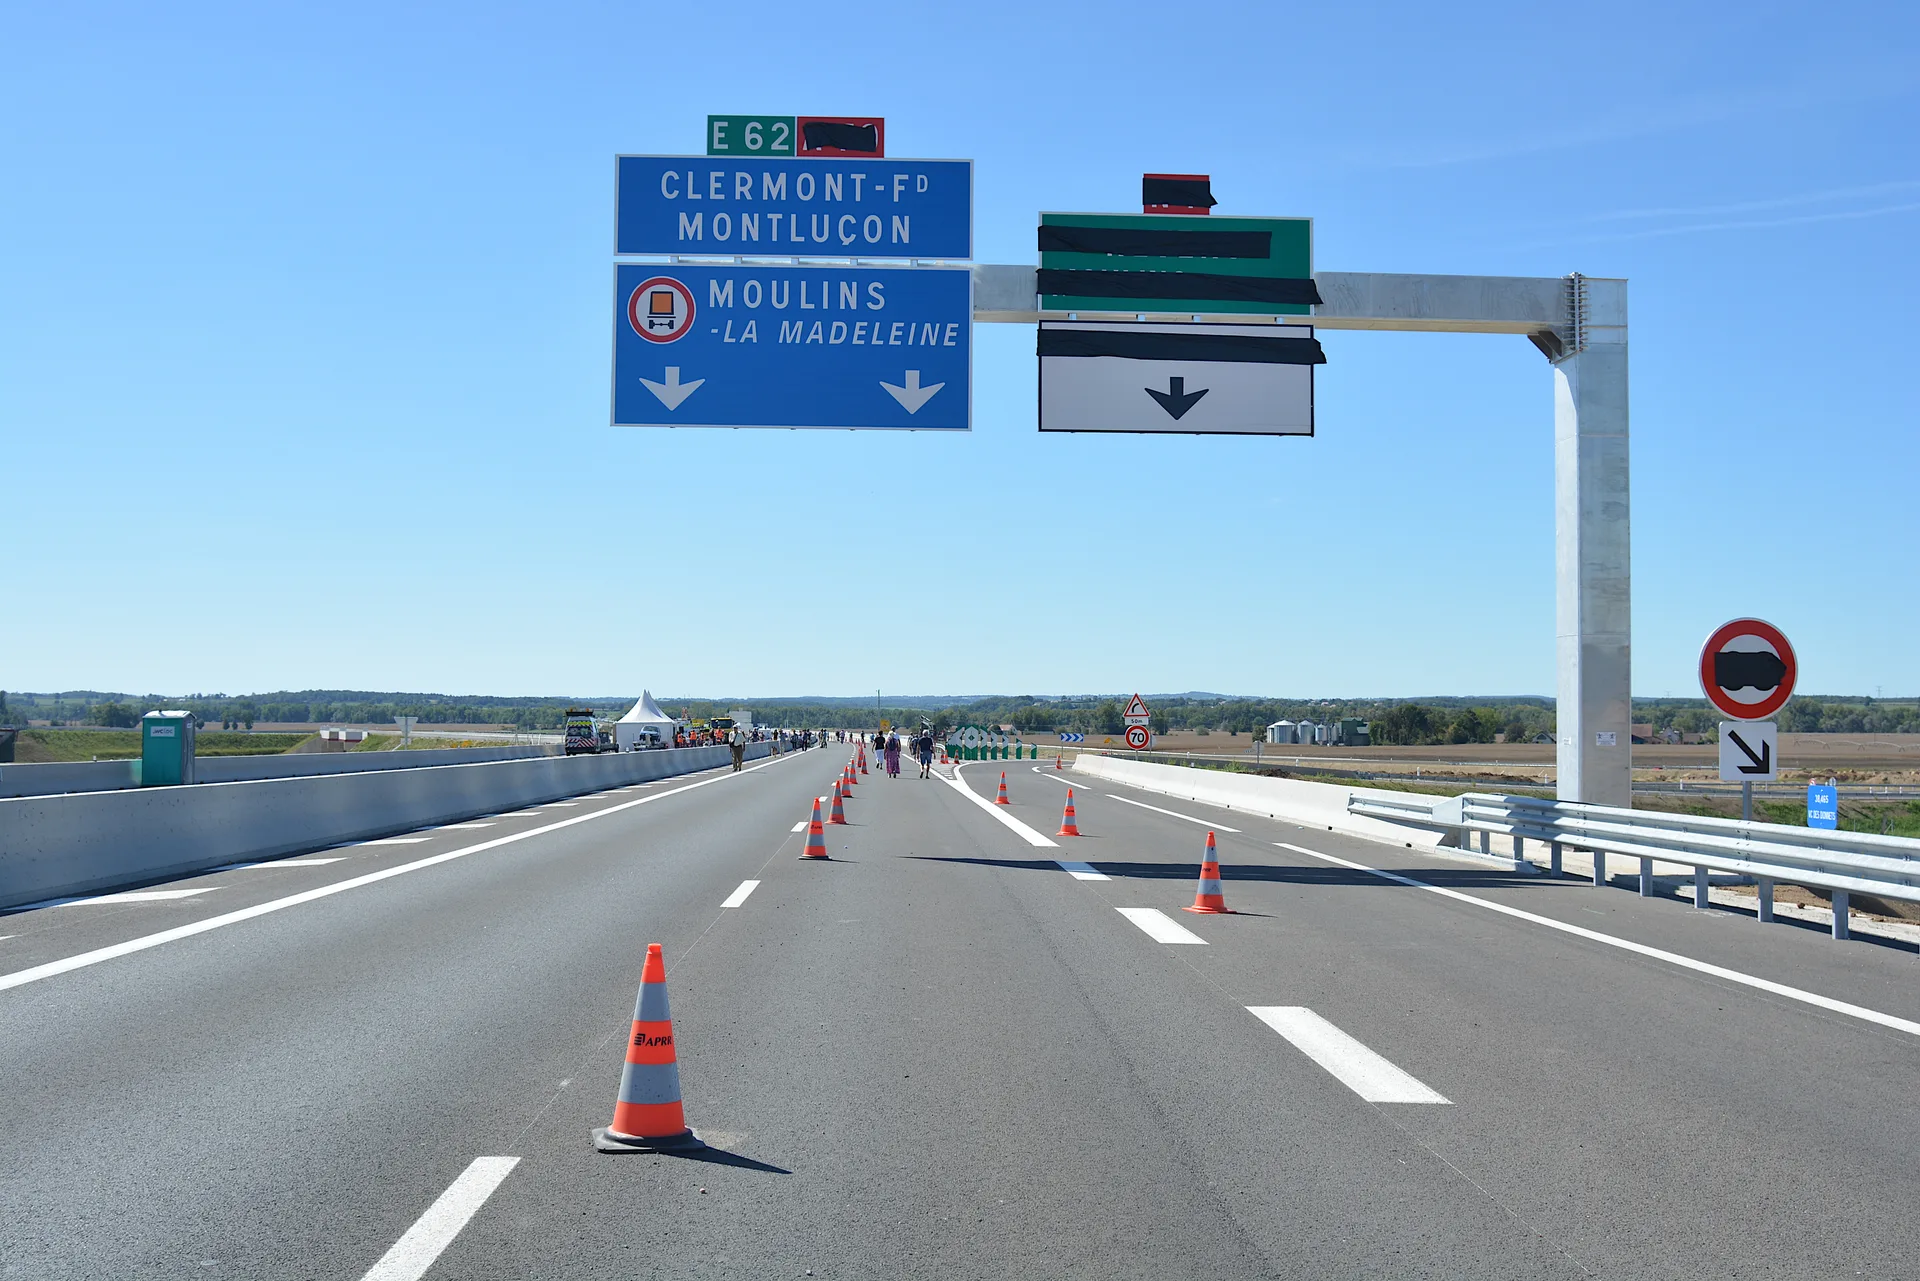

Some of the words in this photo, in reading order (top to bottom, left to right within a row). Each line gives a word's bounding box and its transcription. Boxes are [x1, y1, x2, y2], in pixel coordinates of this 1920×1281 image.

[713, 121, 729, 149] E
[745, 121, 789, 150] 62
[678, 212, 910, 245] MONTLUÇON
[709, 279, 886, 310] MOULINS
[778, 320, 959, 347] MADELEINE
[1131, 732, 1145, 743] 70
[645, 1036, 672, 1046] APRR
